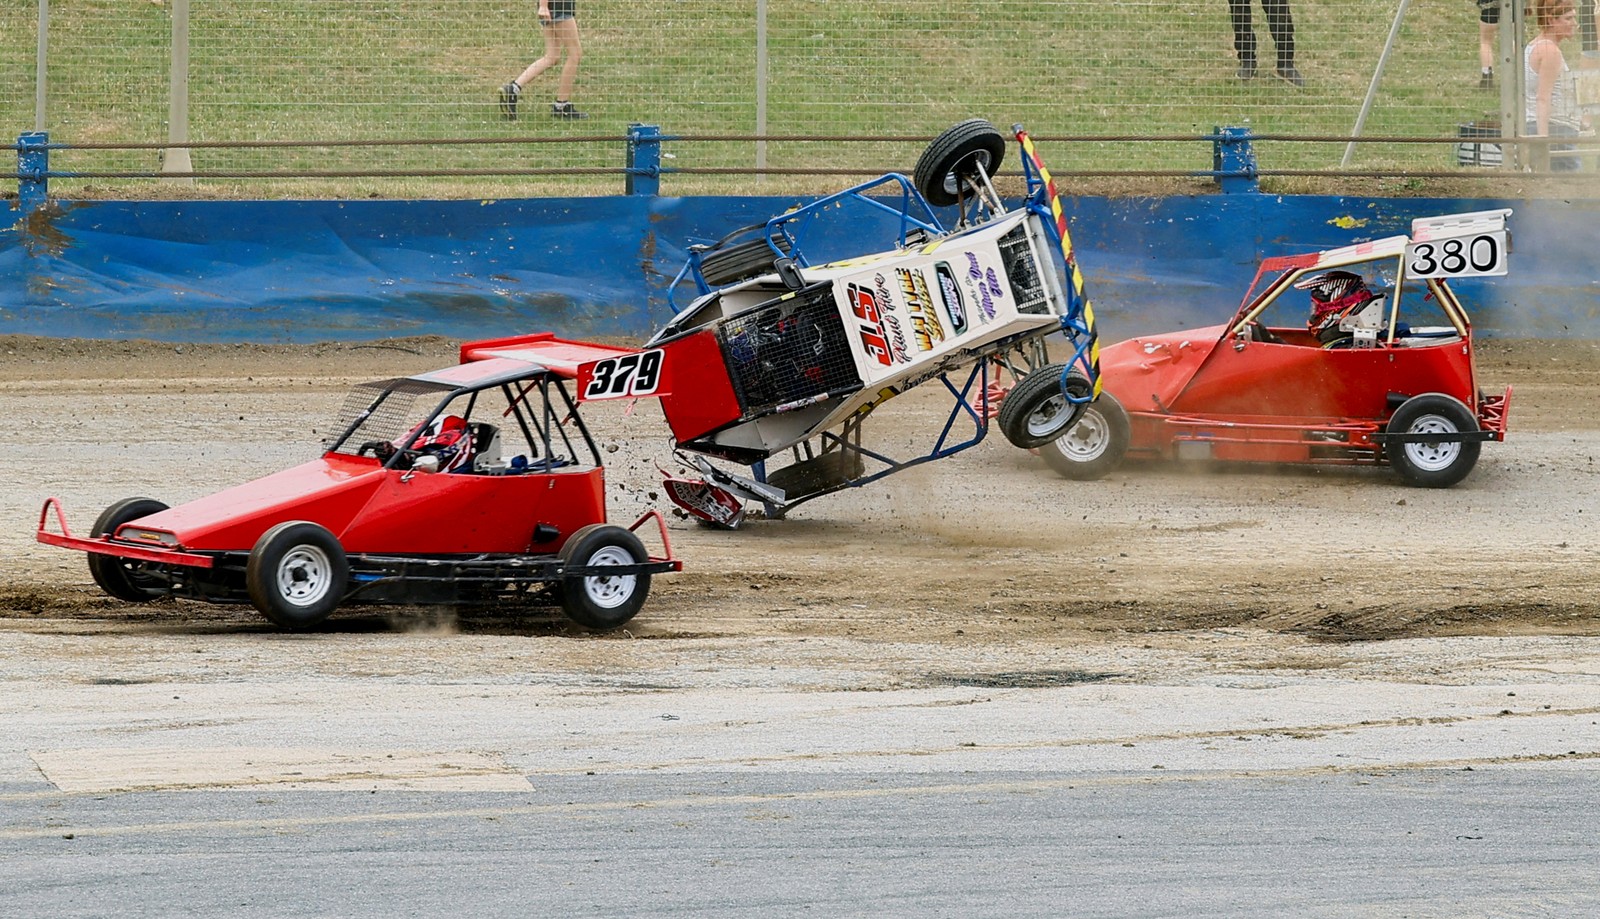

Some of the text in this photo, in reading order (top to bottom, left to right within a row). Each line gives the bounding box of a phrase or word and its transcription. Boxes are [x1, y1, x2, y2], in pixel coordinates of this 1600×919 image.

[1410, 234, 1499, 275] 380
[894, 267, 922, 314] TYRE
[874, 272, 912, 364] Plant Hire
[586, 350, 663, 397] 379
